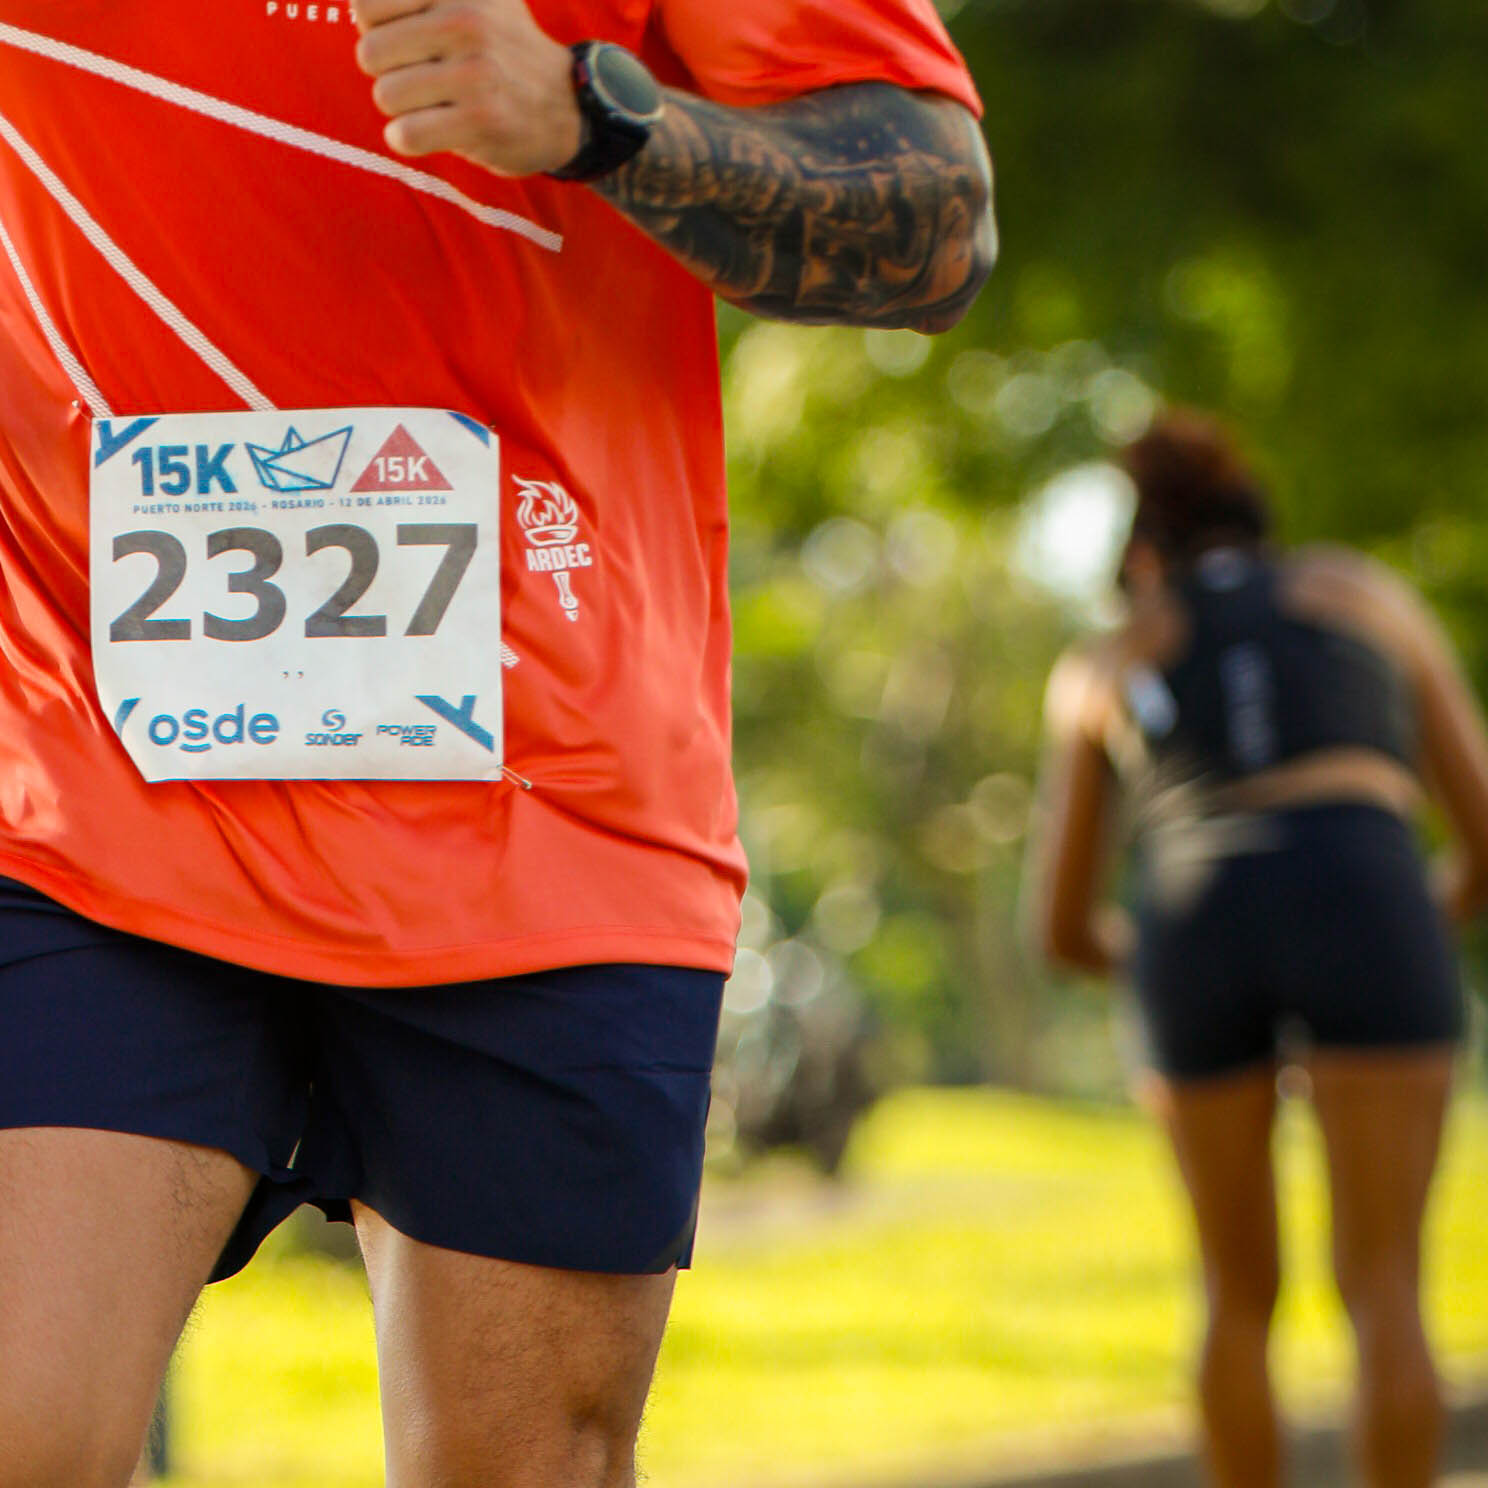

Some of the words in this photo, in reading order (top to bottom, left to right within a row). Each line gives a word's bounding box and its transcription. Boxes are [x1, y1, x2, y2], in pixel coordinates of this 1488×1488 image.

[266, 1, 357, 24] PUERT
[131, 442, 238, 497] 15K
[373, 455, 430, 483] 15K
[133, 503, 180, 514] PUERTO
[184, 502, 223, 513] NORTE
[271, 498, 325, 510] ROSARIO
[357, 496, 372, 507] DE
[377, 496, 412, 506] ABRIL
[525, 543, 592, 572] ARDEC
[109, 523, 478, 642] 2327
[148, 704, 280, 747] osde
[375, 724, 437, 736] POWER
